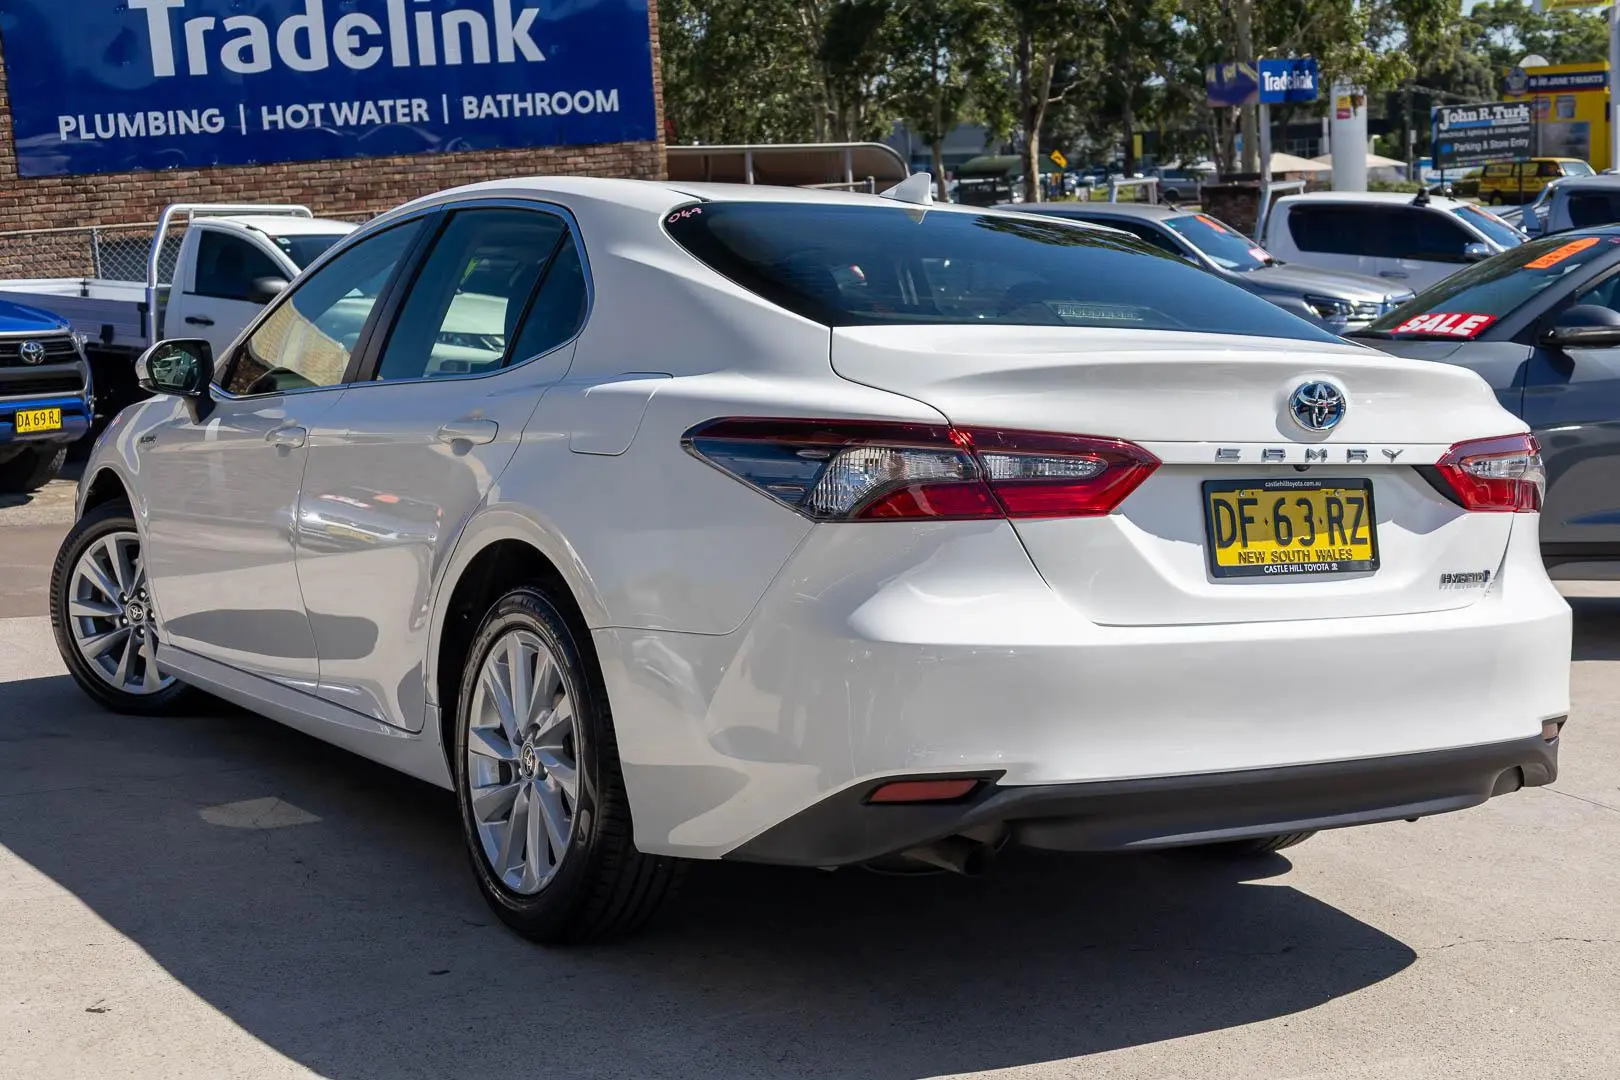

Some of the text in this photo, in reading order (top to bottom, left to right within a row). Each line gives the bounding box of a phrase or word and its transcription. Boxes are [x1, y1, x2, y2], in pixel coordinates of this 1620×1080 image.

[127, 0, 546, 77] Tradelink
[1262, 70, 1314, 92] Tradelink
[58, 89, 619, 141] PLUMBING HOT WATER BATHROOM
[1439, 108, 1477, 130] John
[1479, 107, 1493, 120] R.
[1493, 104, 1529, 119] Turk
[1453, 138, 1529, 152] Parking & Store Entry
[1398, 314, 1489, 336] SALE
[1216, 448, 1404, 462] CAMRY
[1264, 480, 1322, 488] castlehilltoyota.com.au
[1238, 547, 1353, 564] NEW SOUTH WALES
[1264, 563, 1330, 573] CASTLE HILL TOYOTA
